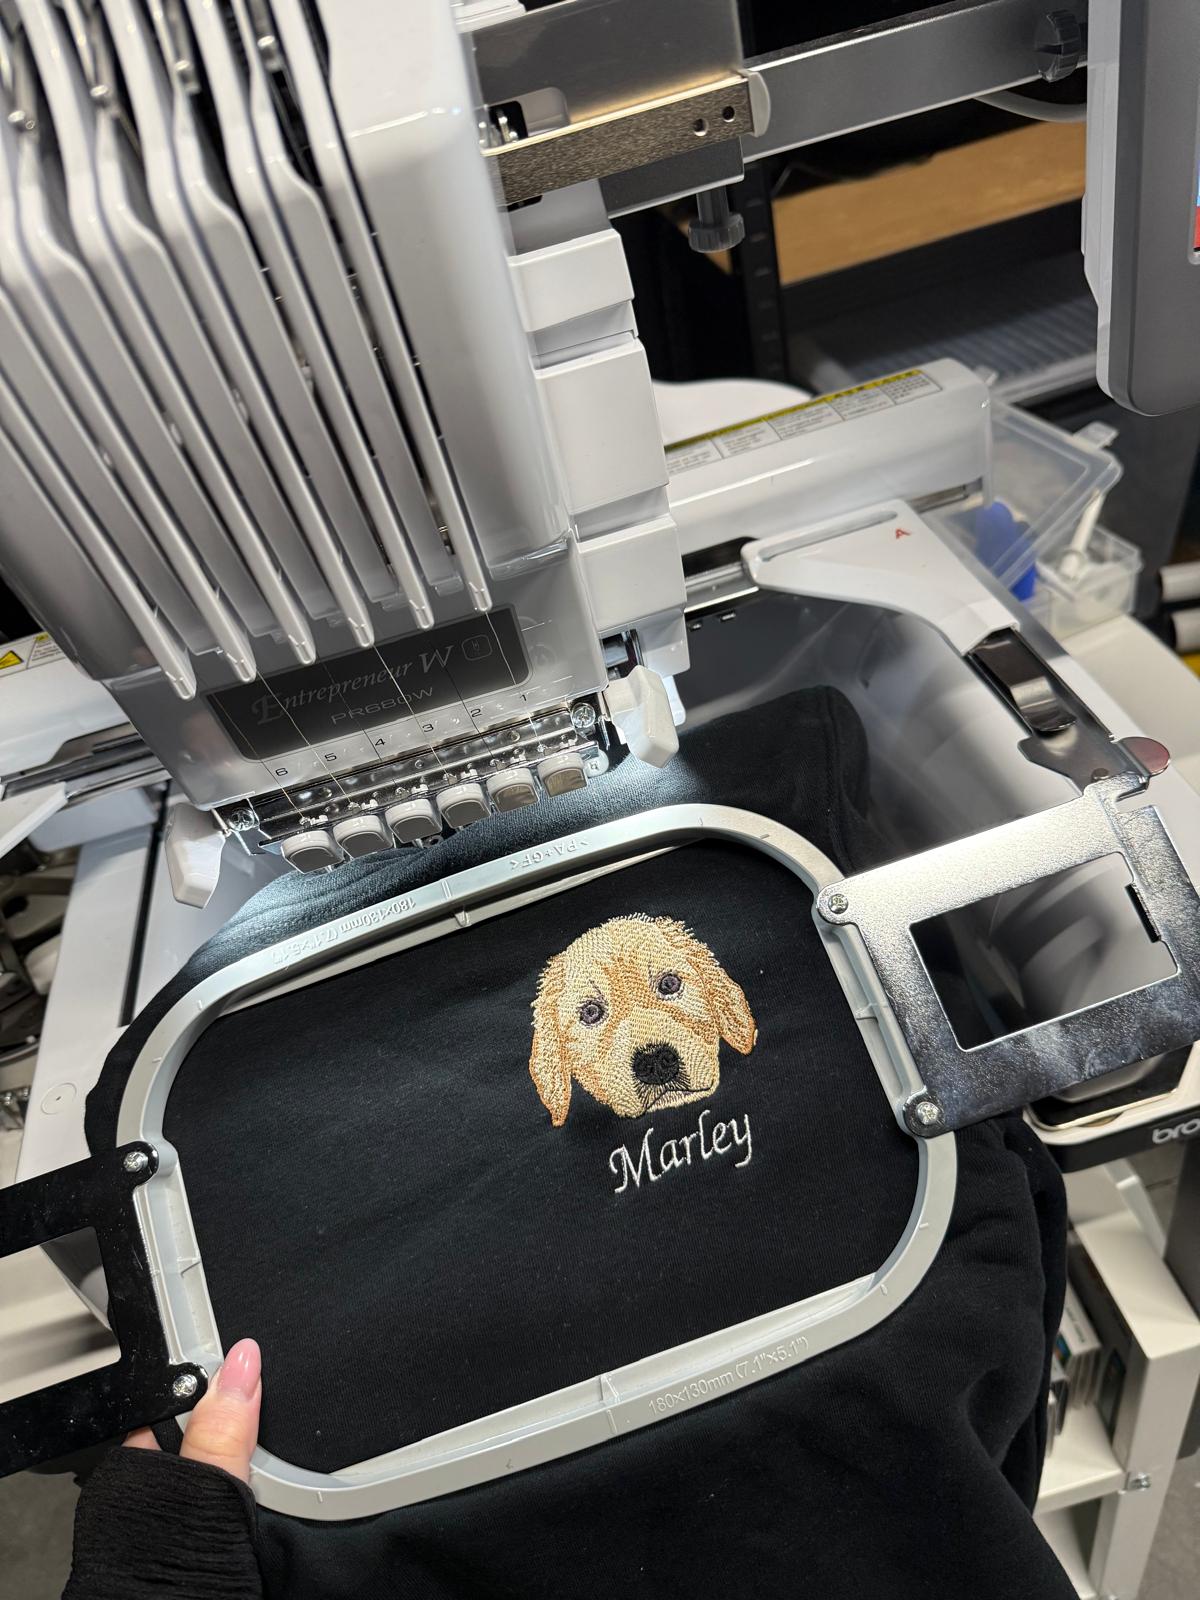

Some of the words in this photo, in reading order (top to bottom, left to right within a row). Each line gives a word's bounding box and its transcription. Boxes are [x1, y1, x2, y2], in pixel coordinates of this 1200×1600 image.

[895, 528, 912, 540] A
[251, 659, 413, 725] Entrepreneur
[418, 644, 455, 674] W
[275, 767, 289, 777] 6
[324, 752, 337, 762] 5
[374, 737, 386, 748] 4
[422, 722, 434, 733] 3
[470, 708, 483, 718] 2
[519, 693, 528, 702] 1
[609, 1109, 752, 1193] Marley
[648, 1371, 735, 1415] 180x130mm
